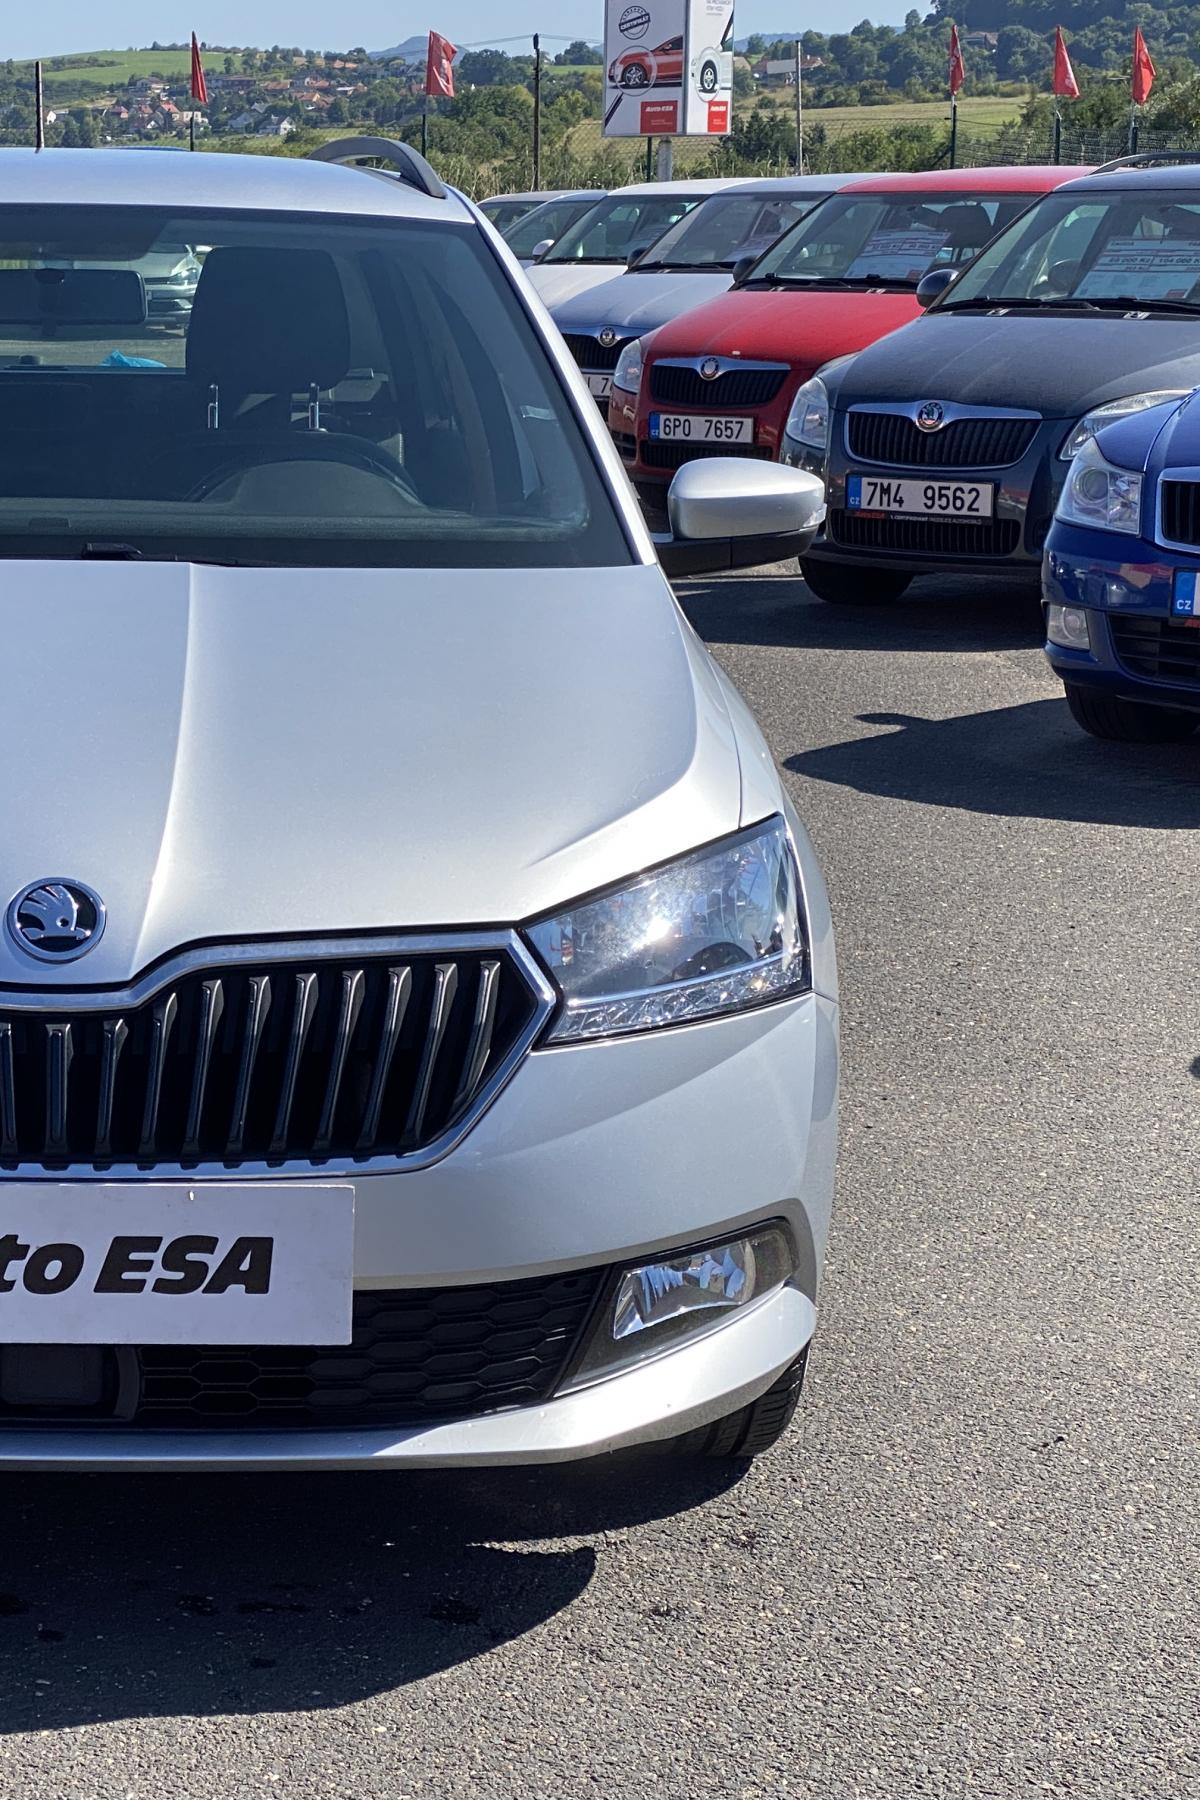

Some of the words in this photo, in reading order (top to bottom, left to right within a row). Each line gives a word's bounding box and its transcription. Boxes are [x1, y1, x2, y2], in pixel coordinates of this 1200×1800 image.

[704, 419, 744, 440] 7657
[850, 496, 860, 504] CZ
[866, 482, 904, 508] 7M4
[923, 485, 980, 512] 9562
[1176, 600, 1192, 610] CZ
[92, 1235, 274, 1295] ESA
